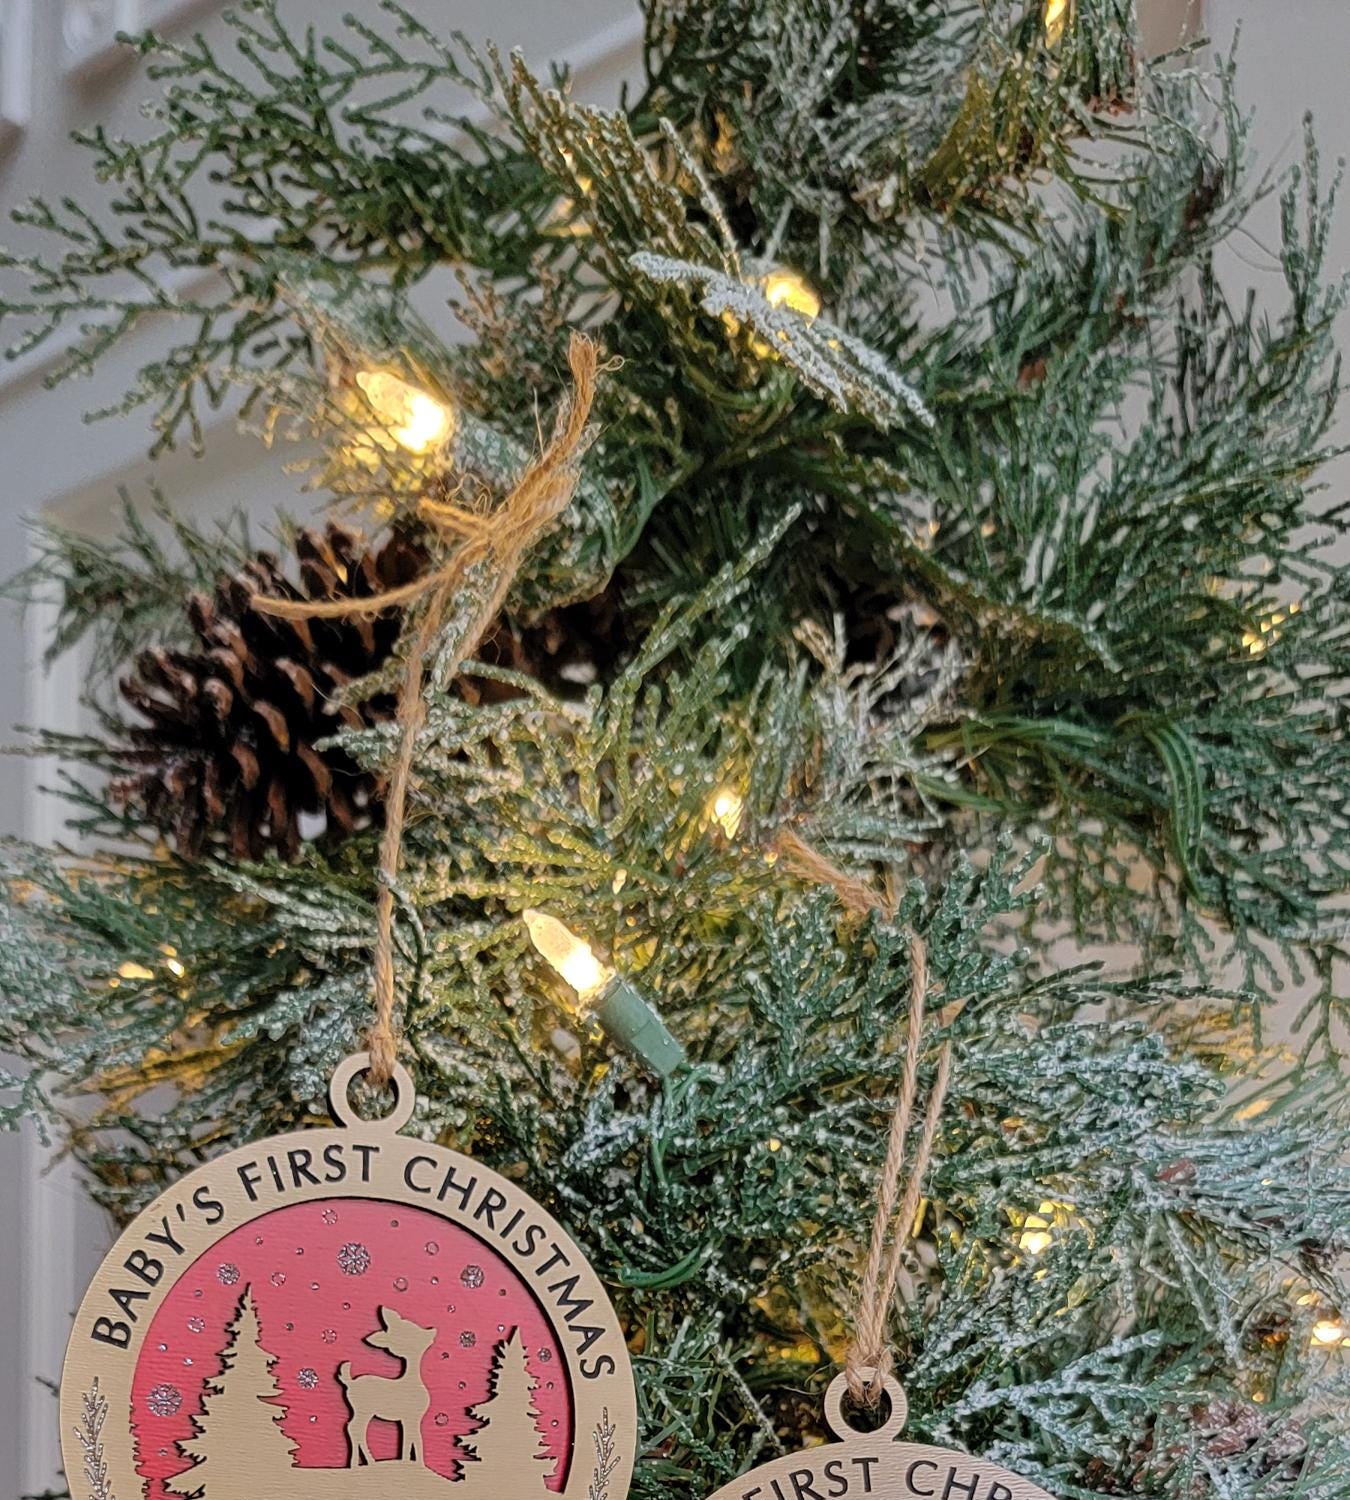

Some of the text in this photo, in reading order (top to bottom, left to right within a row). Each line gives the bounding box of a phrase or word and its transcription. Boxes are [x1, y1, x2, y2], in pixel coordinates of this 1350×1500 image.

[91, 1144, 615, 1380] BABY'S FIRST CHRISTMAS
